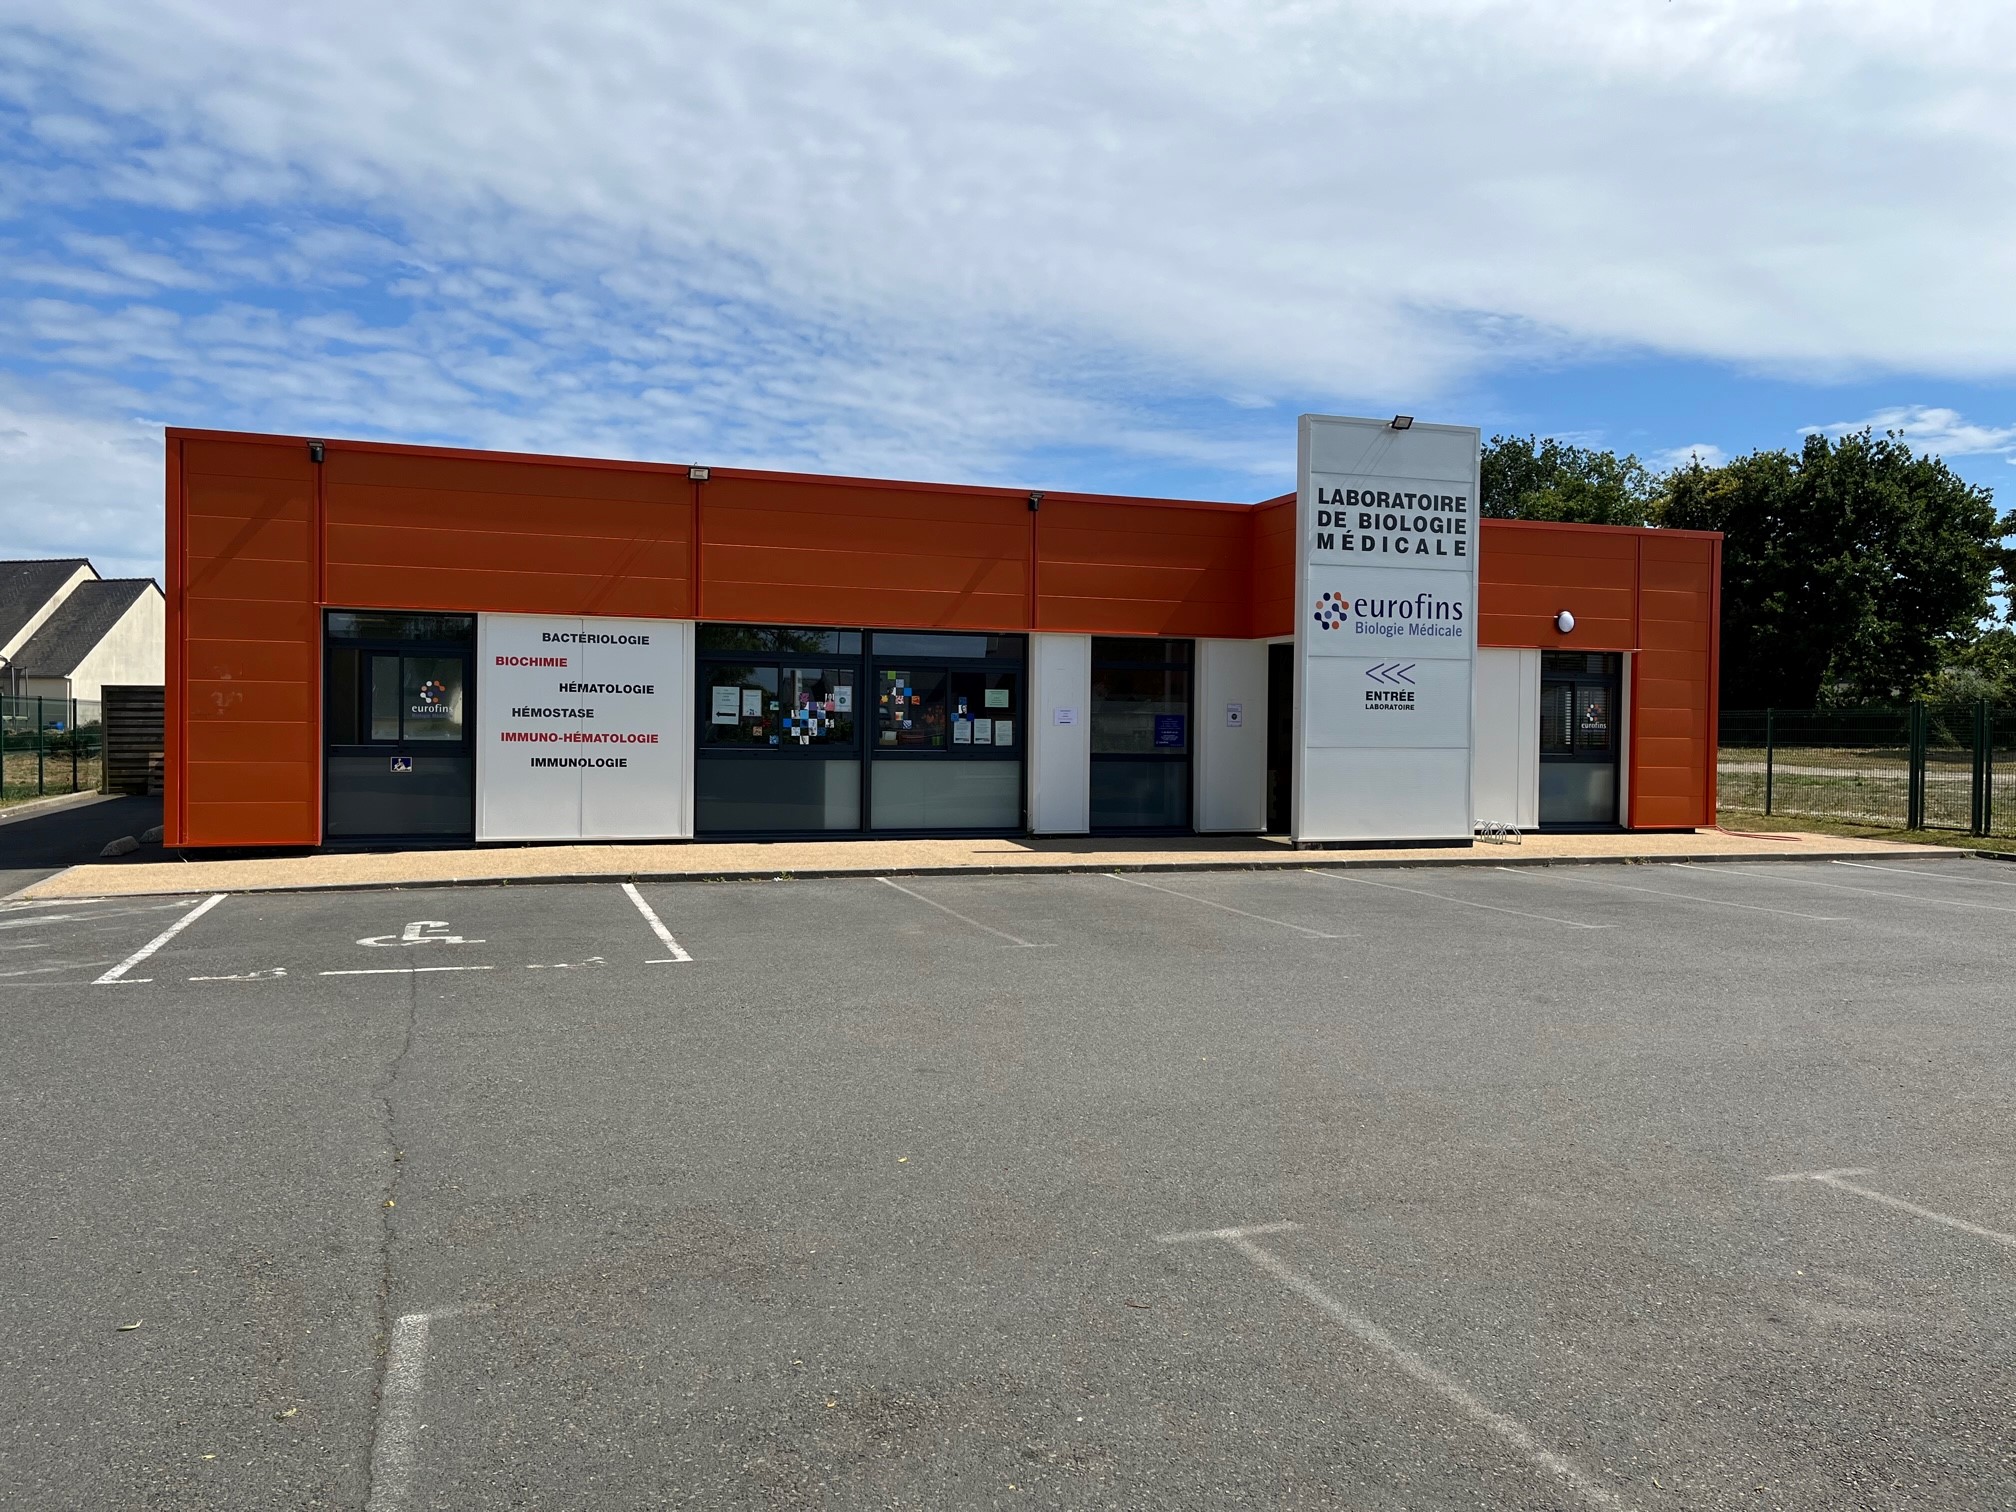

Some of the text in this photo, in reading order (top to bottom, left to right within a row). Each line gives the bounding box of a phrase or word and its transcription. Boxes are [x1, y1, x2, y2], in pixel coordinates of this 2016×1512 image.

[1318, 487, 1467, 513] LABORATOIRE
[1317, 510, 1467, 535] DE BIOLOGIE
[1317, 530, 1467, 557] MÉDICALE
[1354, 593, 1463, 621] eurofins
[1355, 621, 1463, 638] Biologie Médicale
[542, 631, 650, 646] BACTÉRIOLOGIE
[495, 655, 568, 668] BIOCHIMIE
[559, 681, 655, 695] HÉMATOLOGIE
[1365, 689, 1415, 702] ENTRÉE
[411, 704, 454, 713] eurofins
[511, 705, 595, 719] HÉMOSTASE
[1365, 703, 1415, 711] LABORATOIRE
[500, 731, 659, 744] IMMUNO-HÉMATOLOGIE
[530, 757, 628, 768] IMMUNOLOGIE
